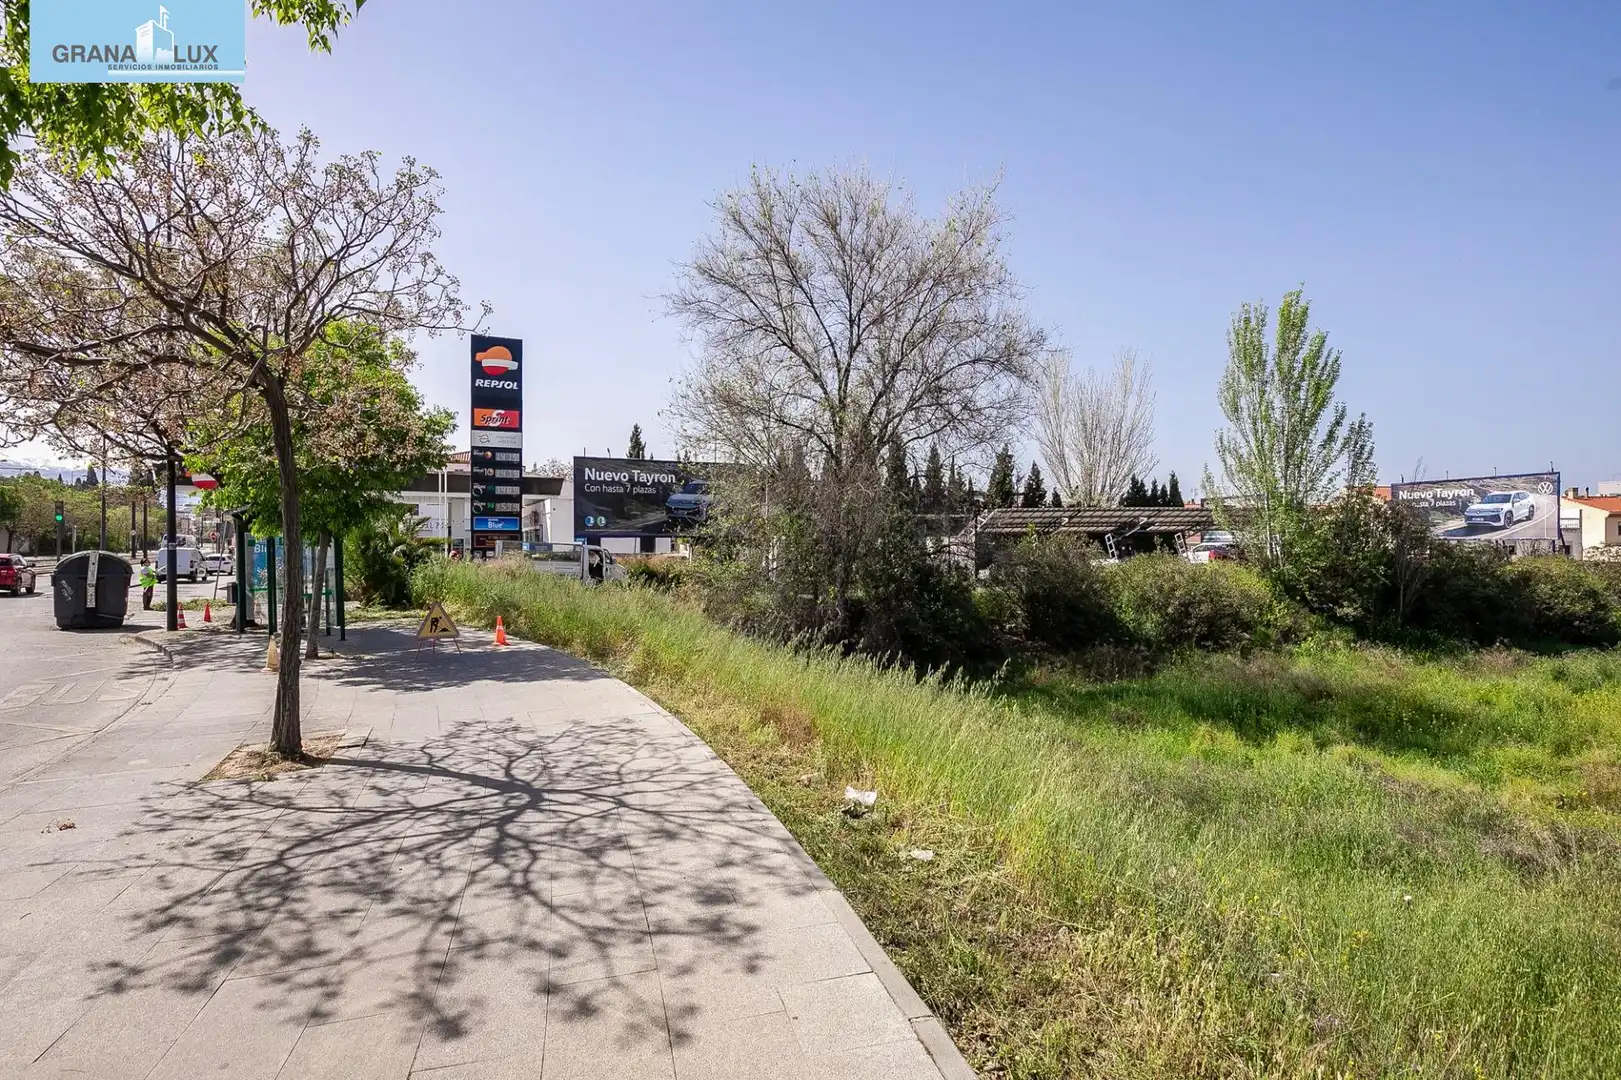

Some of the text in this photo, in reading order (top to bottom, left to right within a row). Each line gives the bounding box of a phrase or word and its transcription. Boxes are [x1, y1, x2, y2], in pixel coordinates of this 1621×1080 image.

[475, 378, 519, 390] REPSOL
[480, 412, 512, 426] Sprint
[584, 467, 676, 486] Nuevo Tayron
[584, 484, 657, 495] Con hasta 7 plazas
[1399, 488, 1475, 500] Nuevo Tayron
[1436, 499, 1456, 508] plazas
